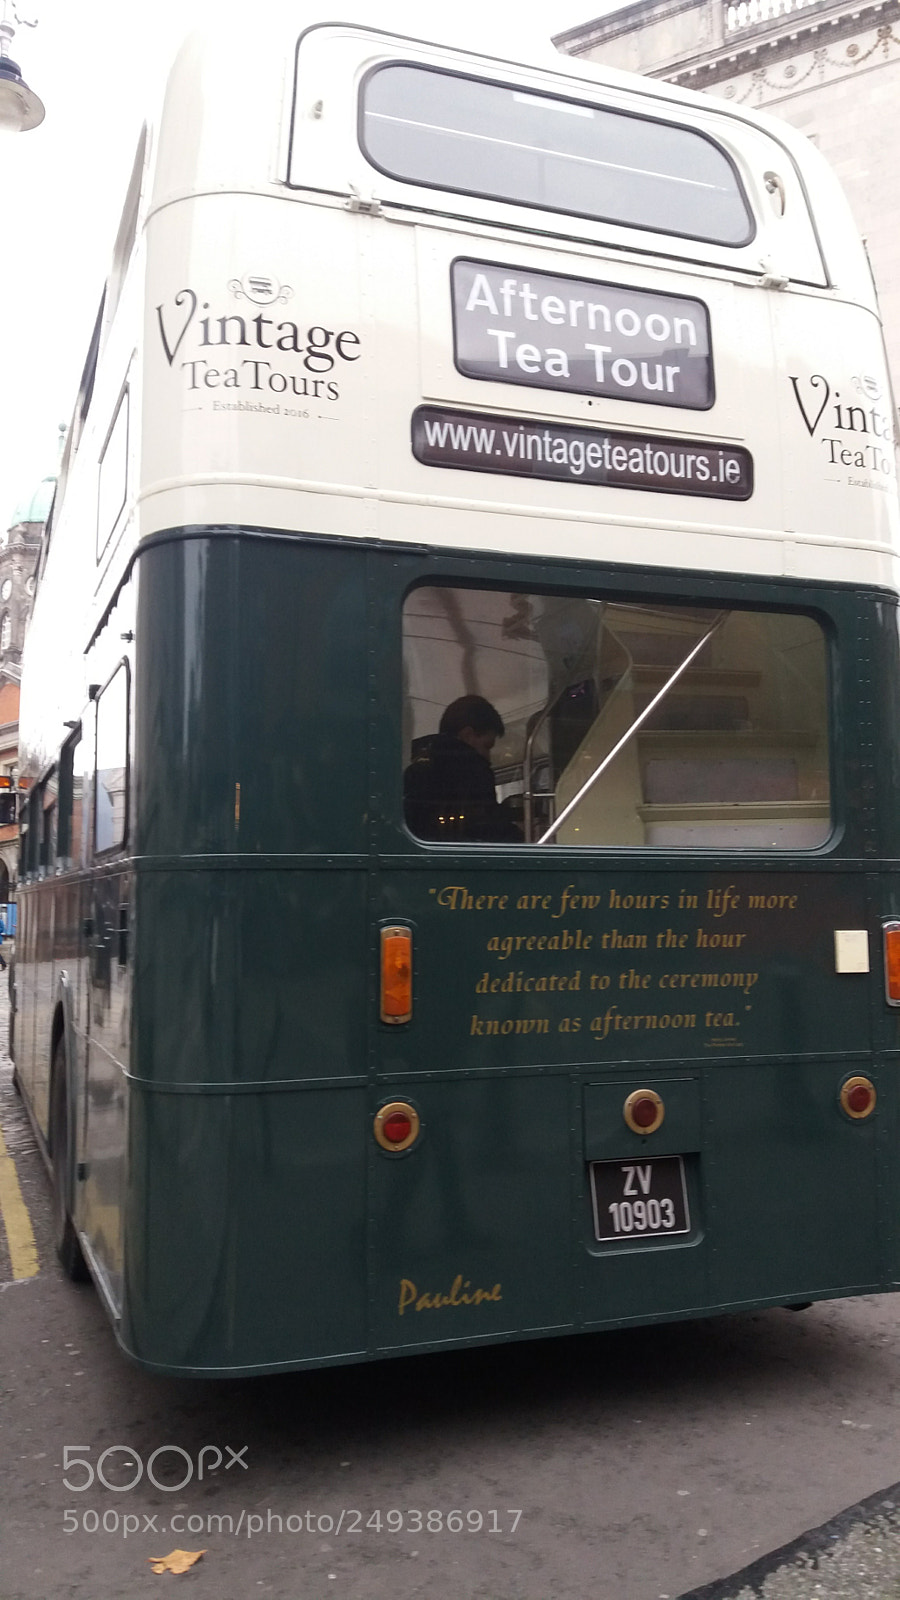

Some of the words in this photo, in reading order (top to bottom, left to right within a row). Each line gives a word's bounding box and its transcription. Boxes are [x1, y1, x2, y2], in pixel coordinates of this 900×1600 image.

[465, 273, 698, 346] Afternoon
[155, 288, 362, 373] Vintage
[486, 328, 571, 378] Tea
[584, 342, 681, 393] Tour
[212, 400, 281, 416] Established
[284, 406, 310, 419] 2016
[424, 419, 741, 484] www.vintageteatours.ie
[516, 894, 552, 910] are
[551, 884, 601, 919] few
[608, 889, 670, 910] hours
[678, 889, 699, 909] in
[706, 885, 740, 918] life
[749, 894, 799, 909] more
[486, 929, 593, 960] agreeable
[601, 929, 648, 949] than
[656, 929, 689, 949] the
[696, 929, 747, 948] hour
[475, 970, 582, 993] dedicated
[590, 975, 611, 990] to
[619, 969, 652, 990] the
[658, 973, 759, 994] ceremony
[470, 1015, 550, 1036] known
[558, 1018, 582, 1032] as
[590, 1005, 697, 1040] afternoon
[621, 1165, 652, 1196] ZV
[608, 1198, 676, 1233] 10903
[398, 1274, 503, 1316] Pauline
